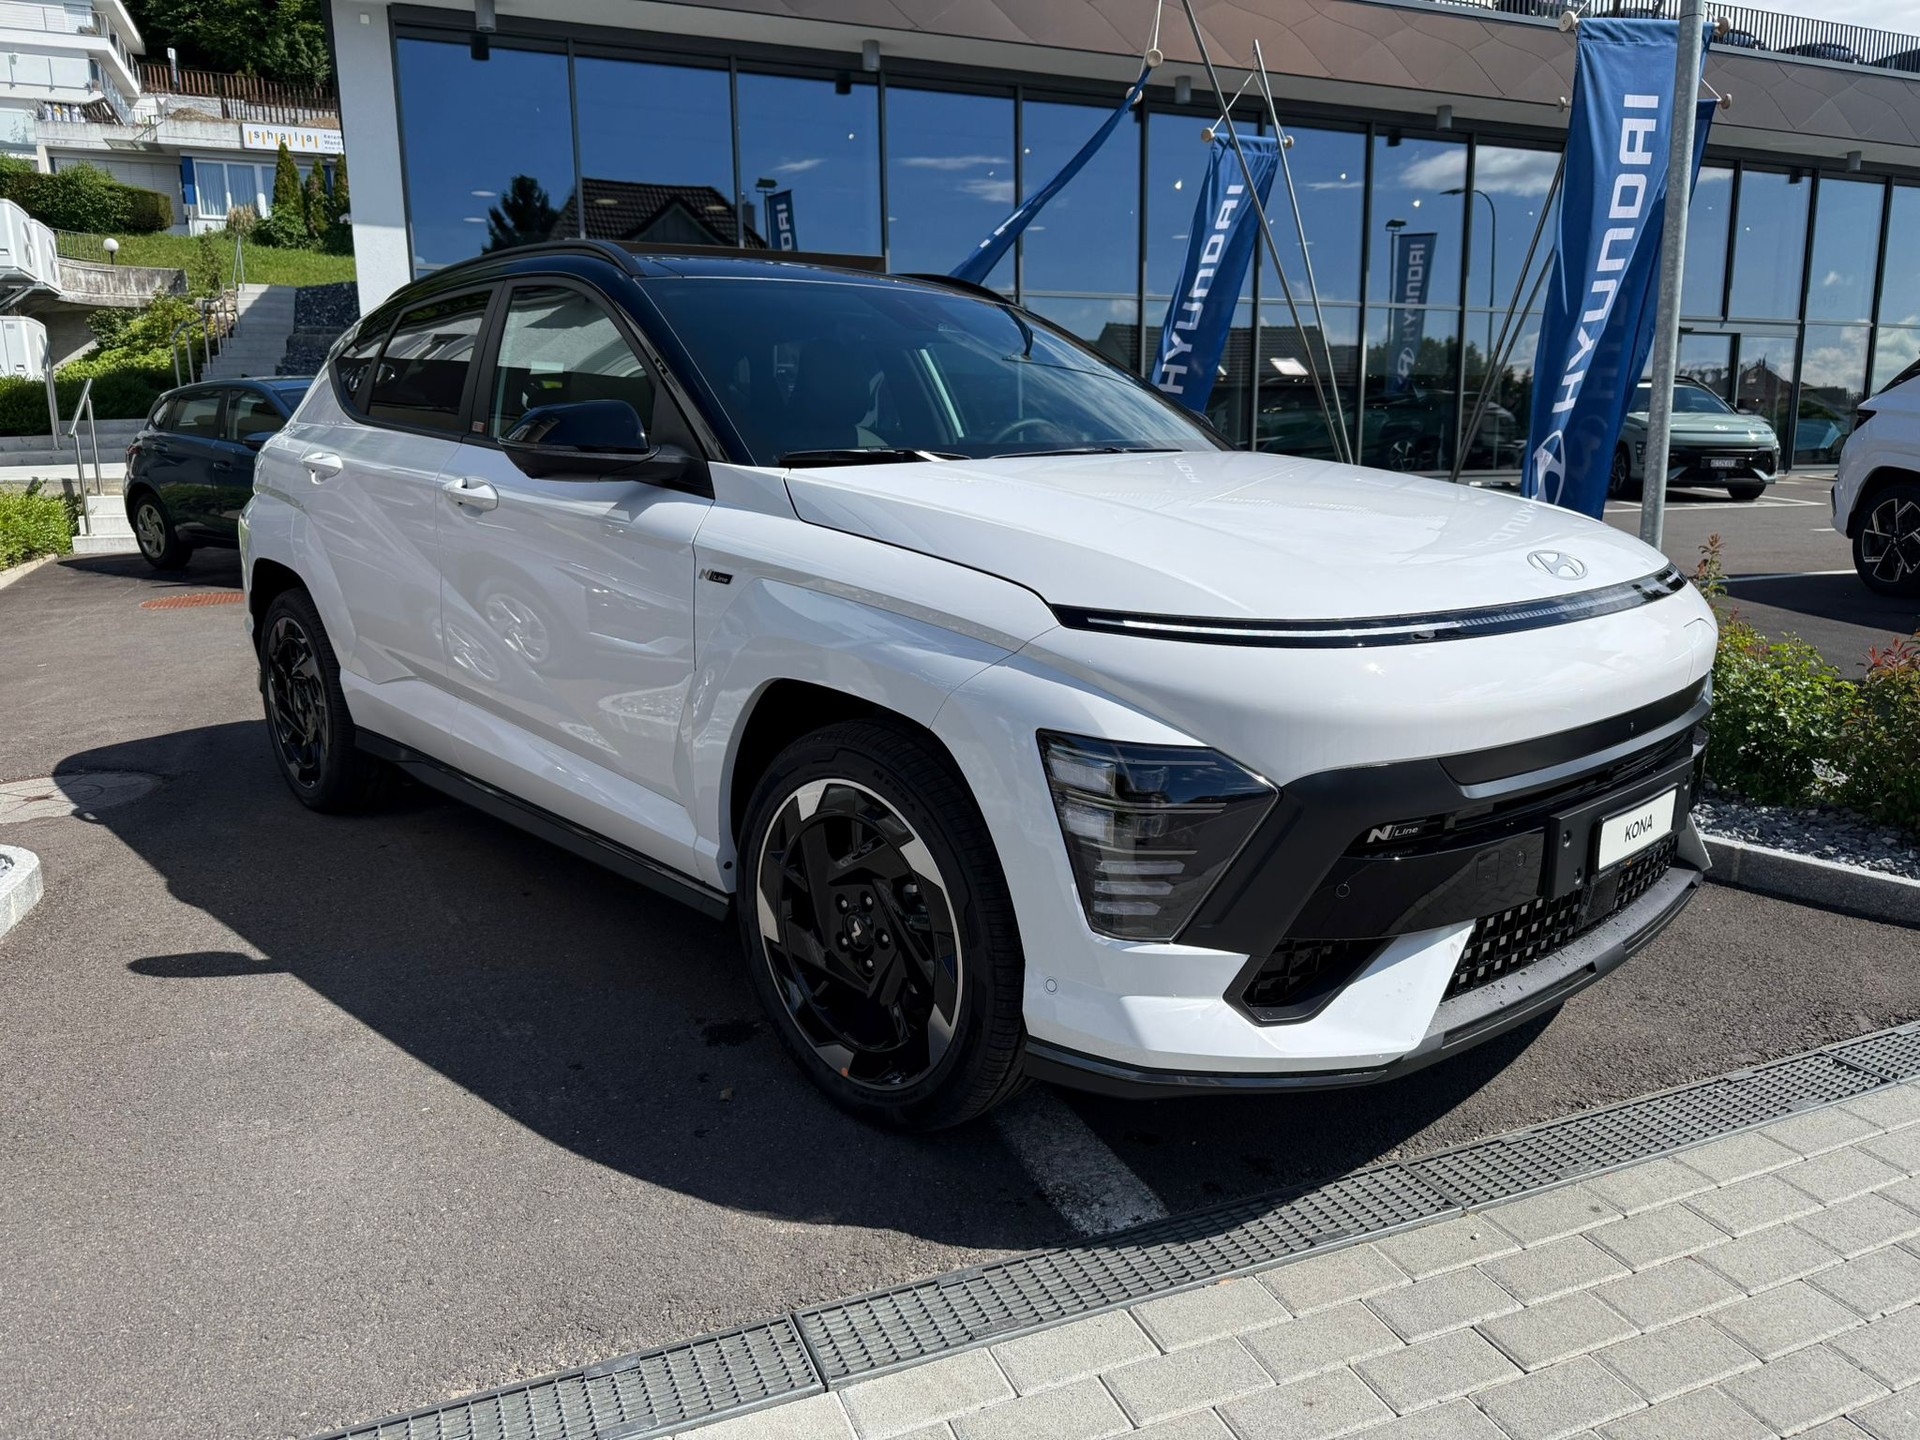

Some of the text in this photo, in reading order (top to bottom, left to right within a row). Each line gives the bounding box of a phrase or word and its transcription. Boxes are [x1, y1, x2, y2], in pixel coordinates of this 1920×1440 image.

[253, 130, 313, 143] shala
[1551, 94, 1660, 414] HYUNDAI
[1158, 184, 1245, 395] HYUNDAI
[1366, 824, 1419, 844] N Line
[1624, 813, 1654, 843] KONA
